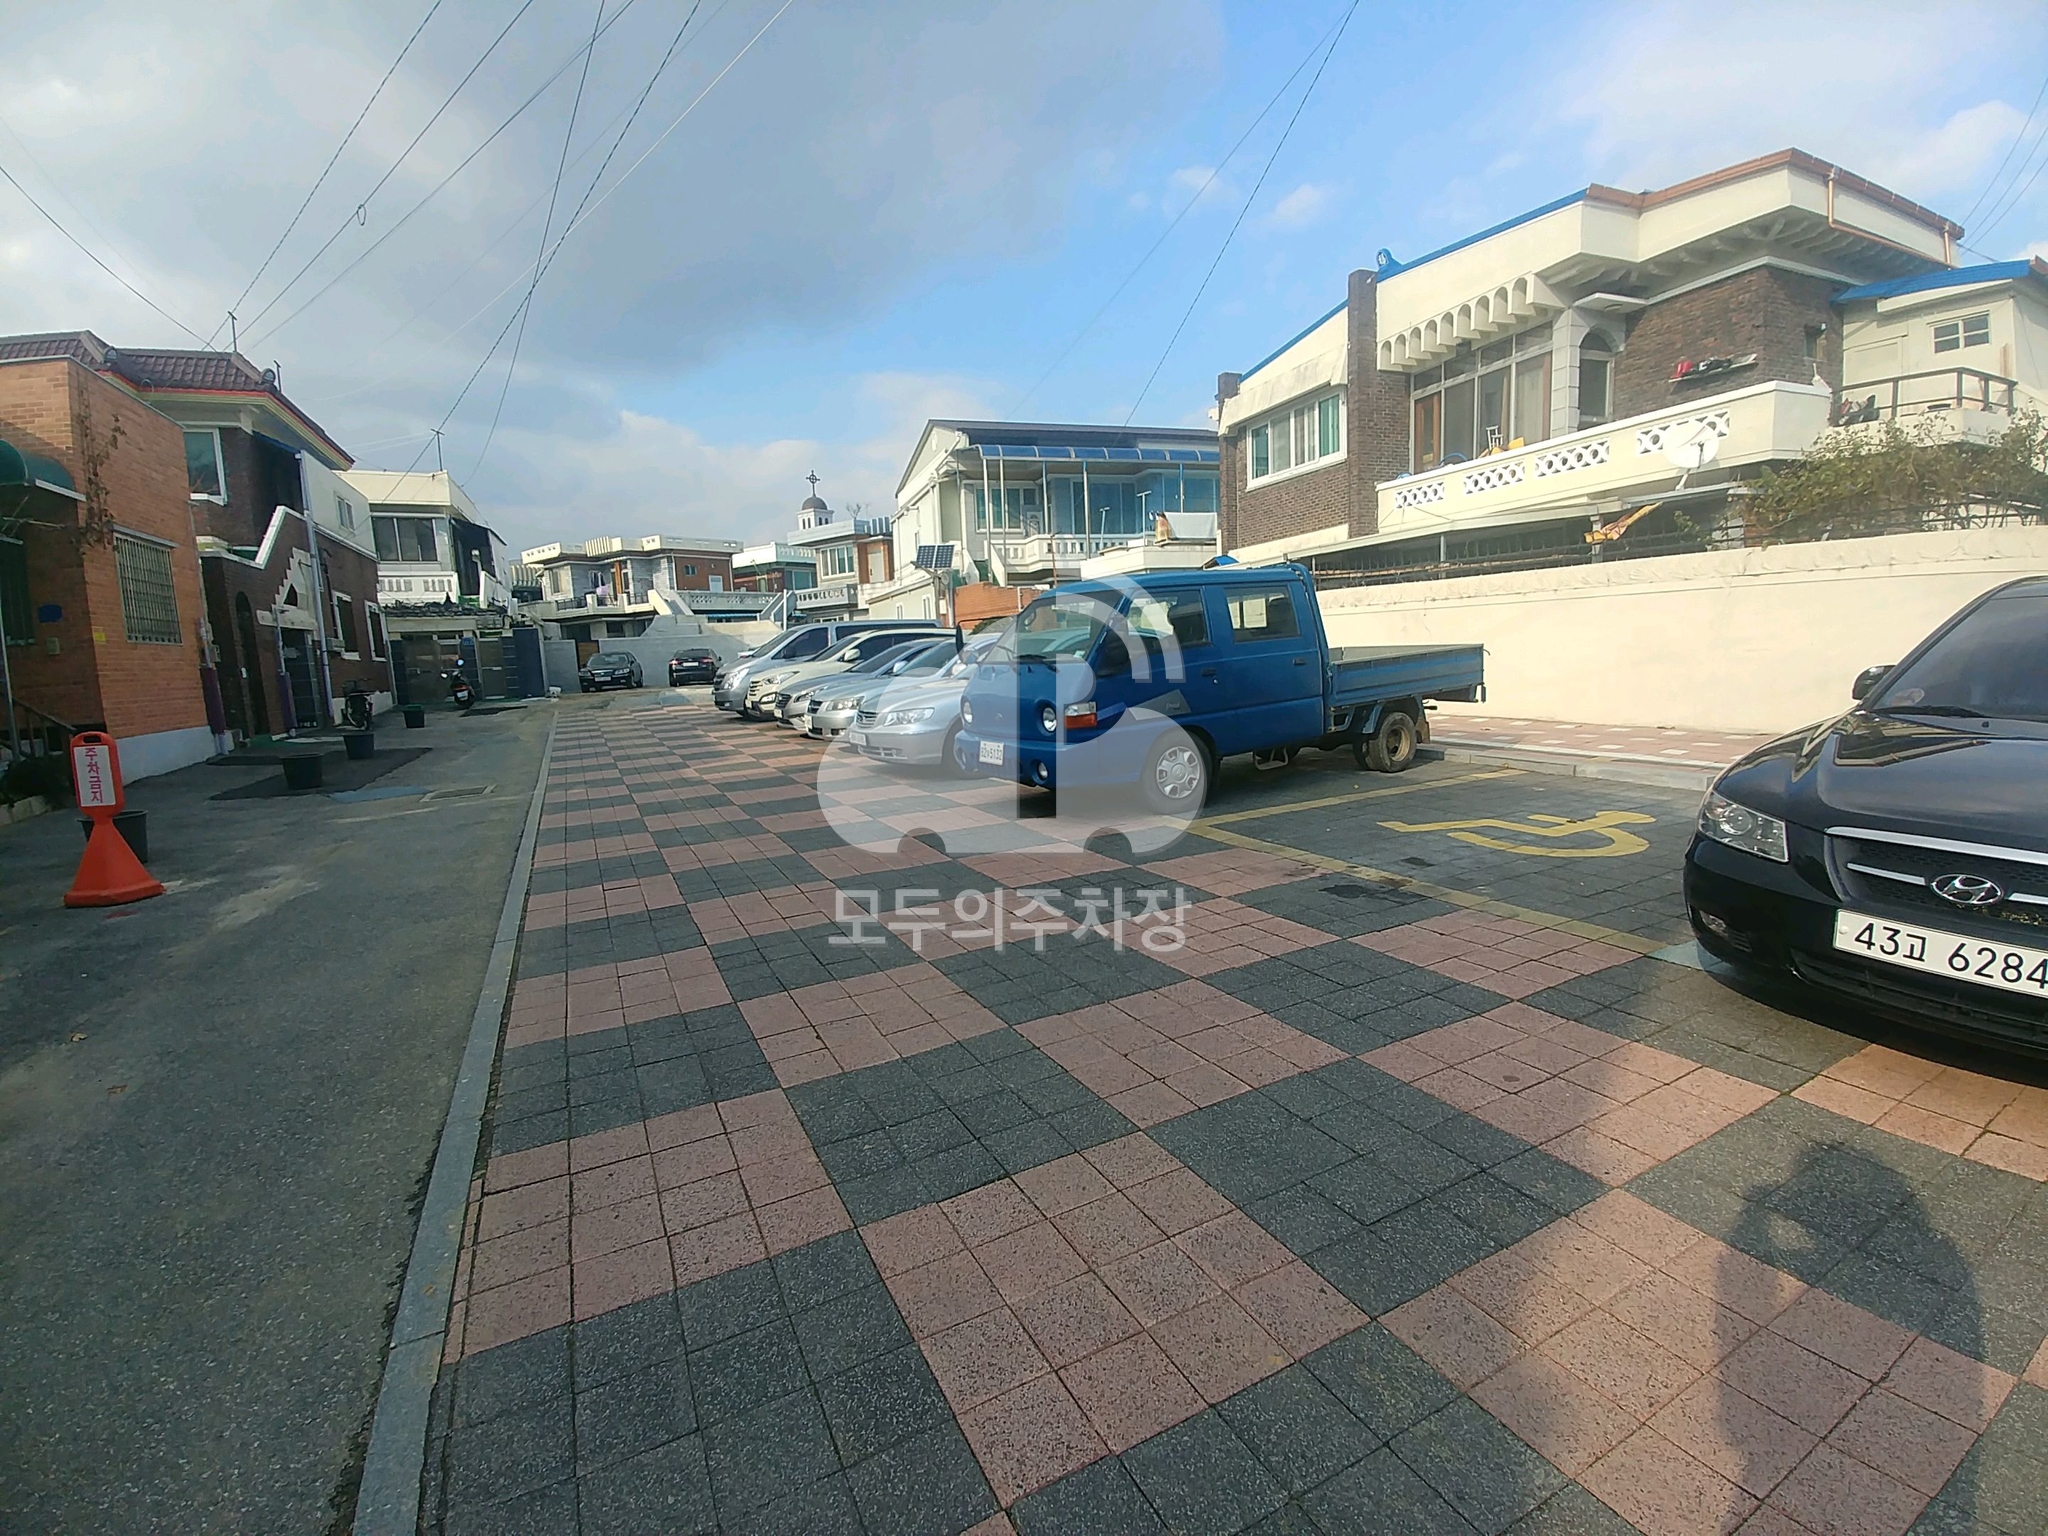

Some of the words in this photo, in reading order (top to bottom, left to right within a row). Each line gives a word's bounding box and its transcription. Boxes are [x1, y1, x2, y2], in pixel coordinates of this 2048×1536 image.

[84, 747, 104, 804] 주차금지
[1854, 922, 1927, 963] 43고
[1947, 941, 2048, 990] 6284
